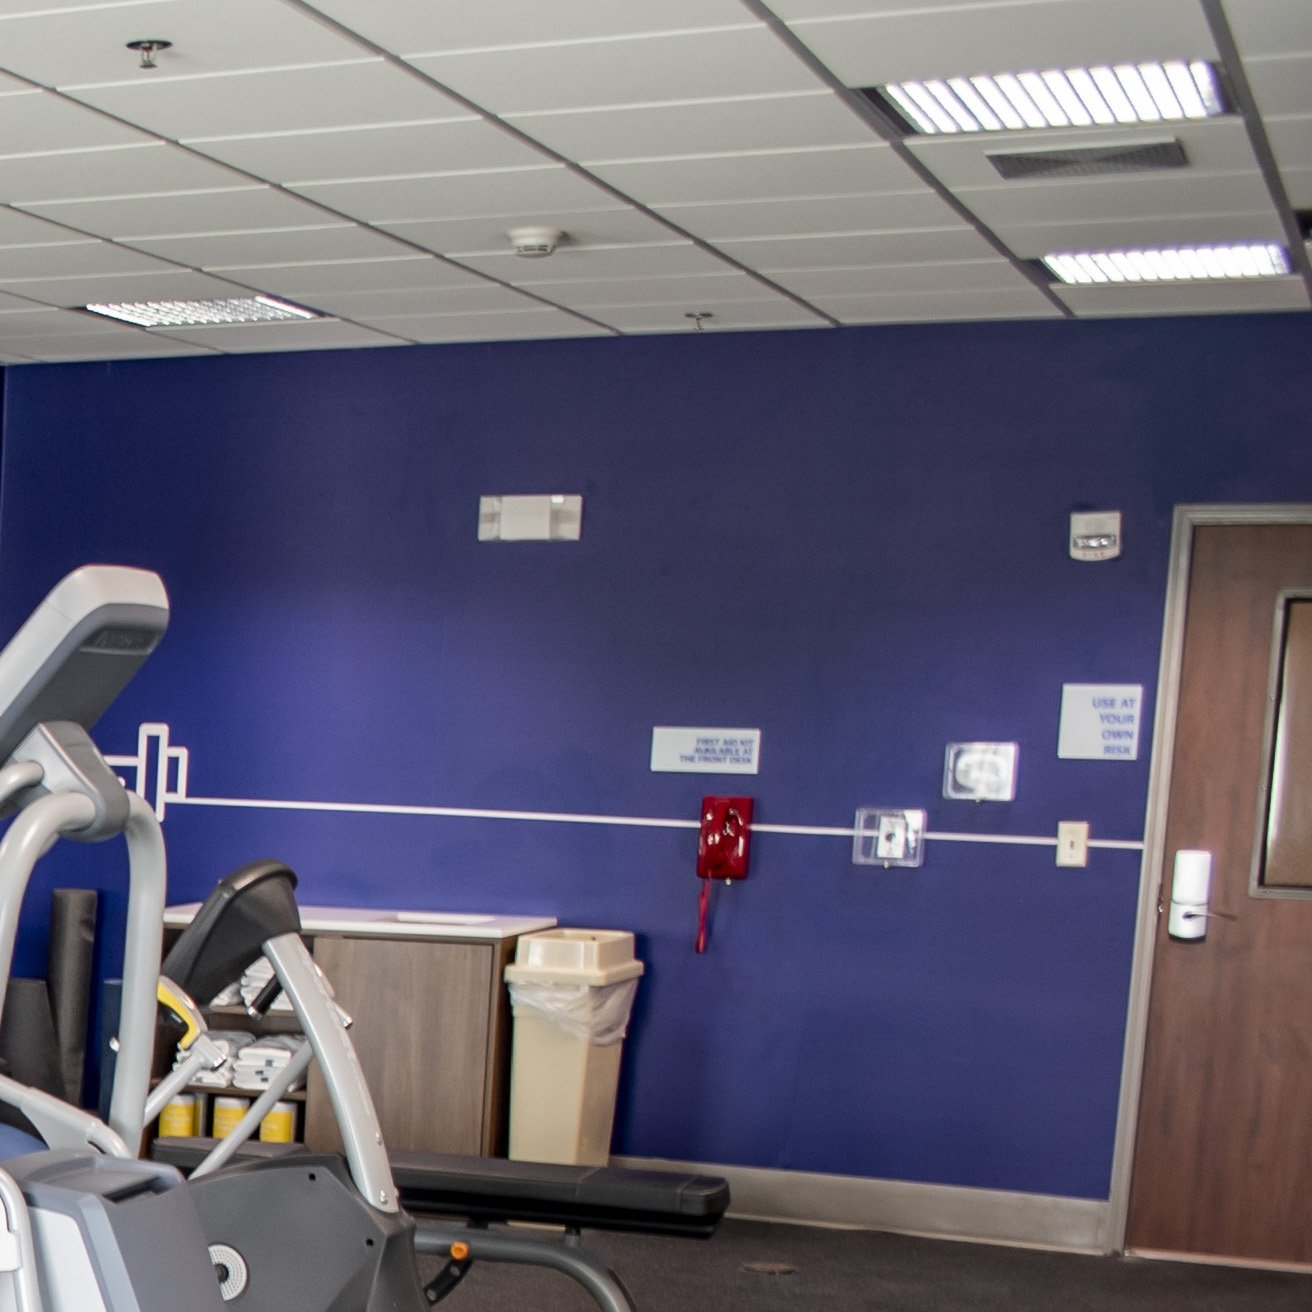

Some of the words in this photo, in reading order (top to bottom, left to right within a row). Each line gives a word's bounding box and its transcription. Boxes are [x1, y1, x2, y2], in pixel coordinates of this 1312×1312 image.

[1092, 697, 1116, 709] USE
[1120, 697, 1136, 709] AT
[1099, 713, 1135, 724] YOUR
[1101, 730, 1134, 741] OWN
